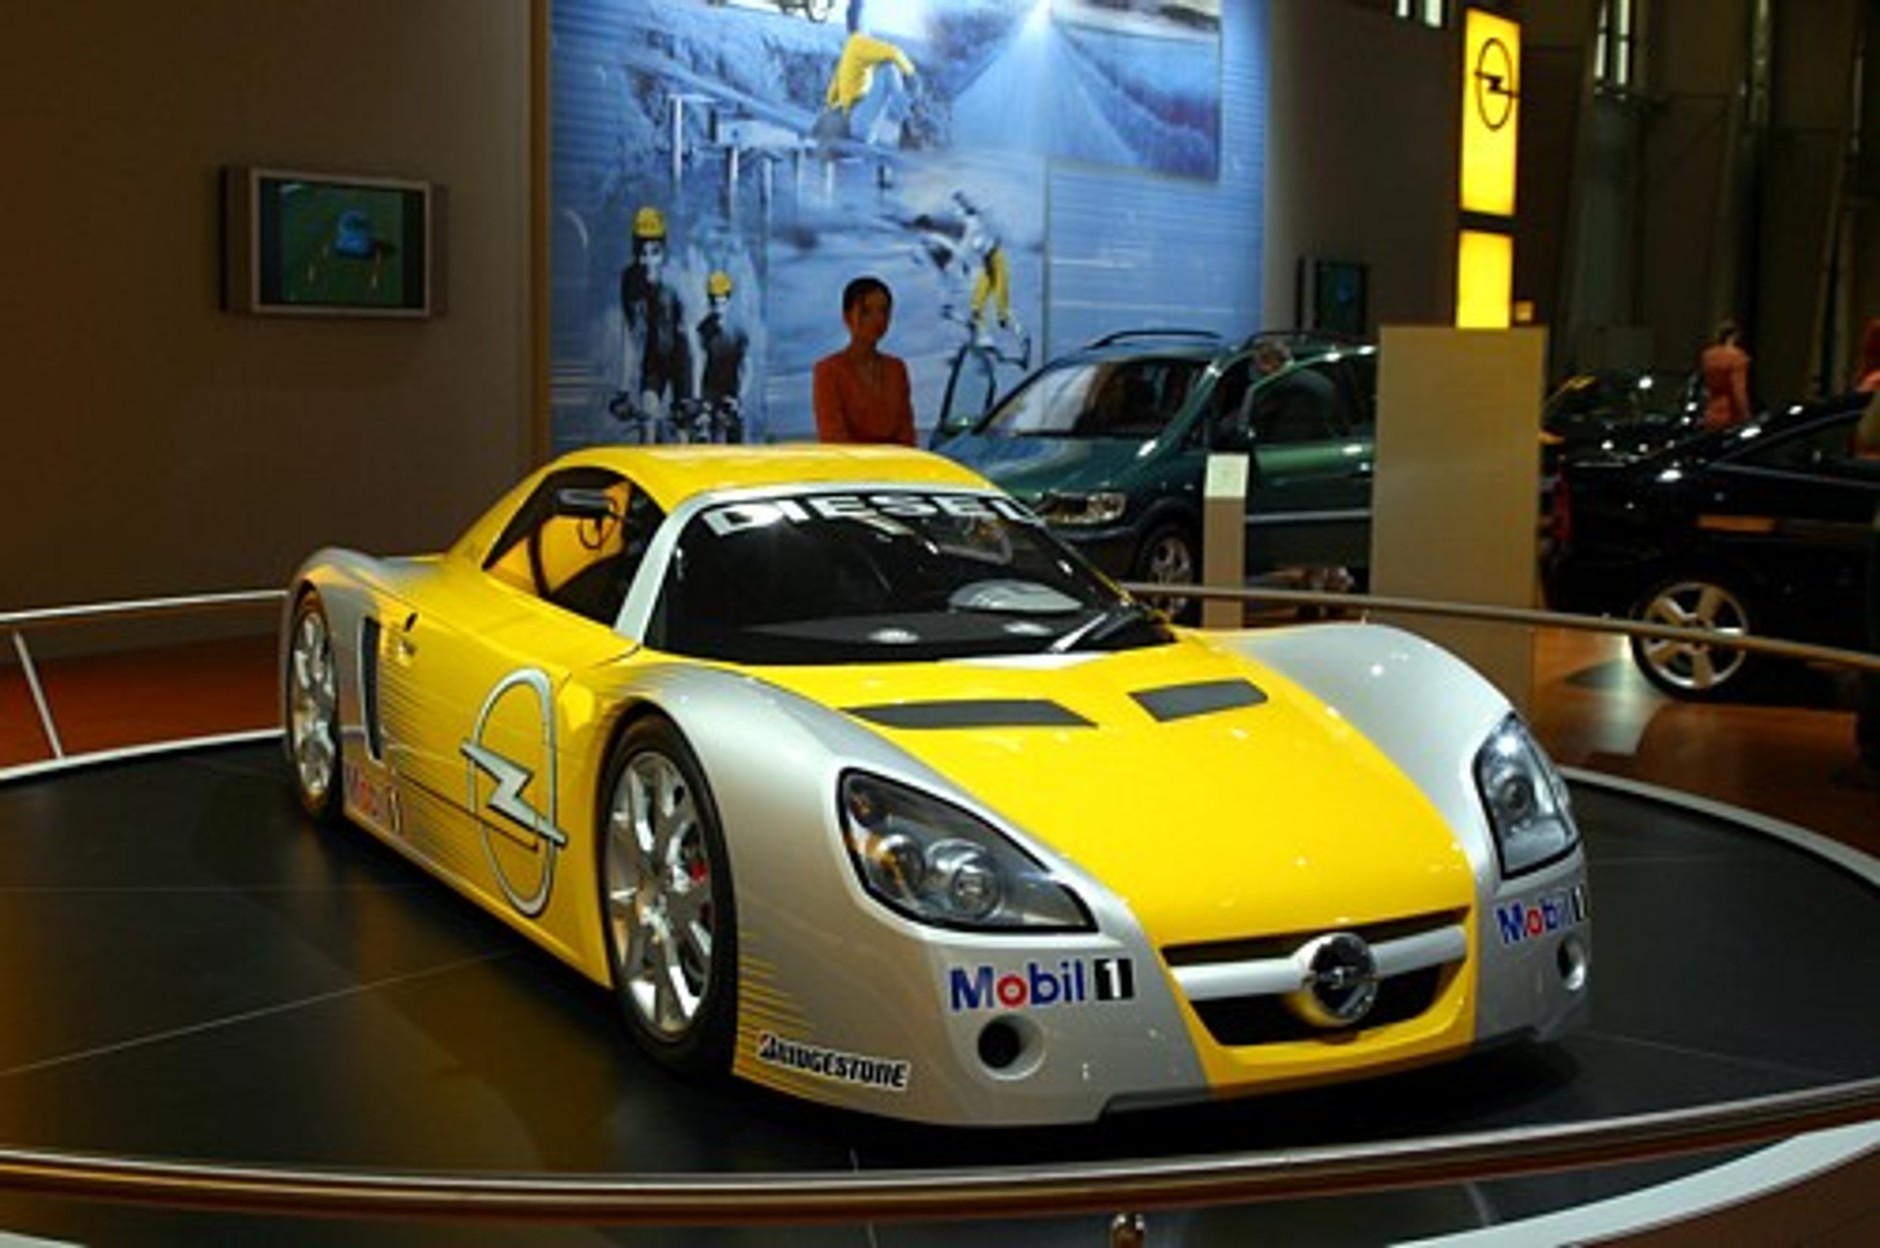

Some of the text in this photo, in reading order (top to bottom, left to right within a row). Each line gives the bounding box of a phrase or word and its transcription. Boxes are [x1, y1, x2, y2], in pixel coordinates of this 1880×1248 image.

[702, 496, 1046, 536] DIESEL
[950, 959, 1084, 1010] Mobil
[759, 1032, 908, 1088] BRIDGESTONE
